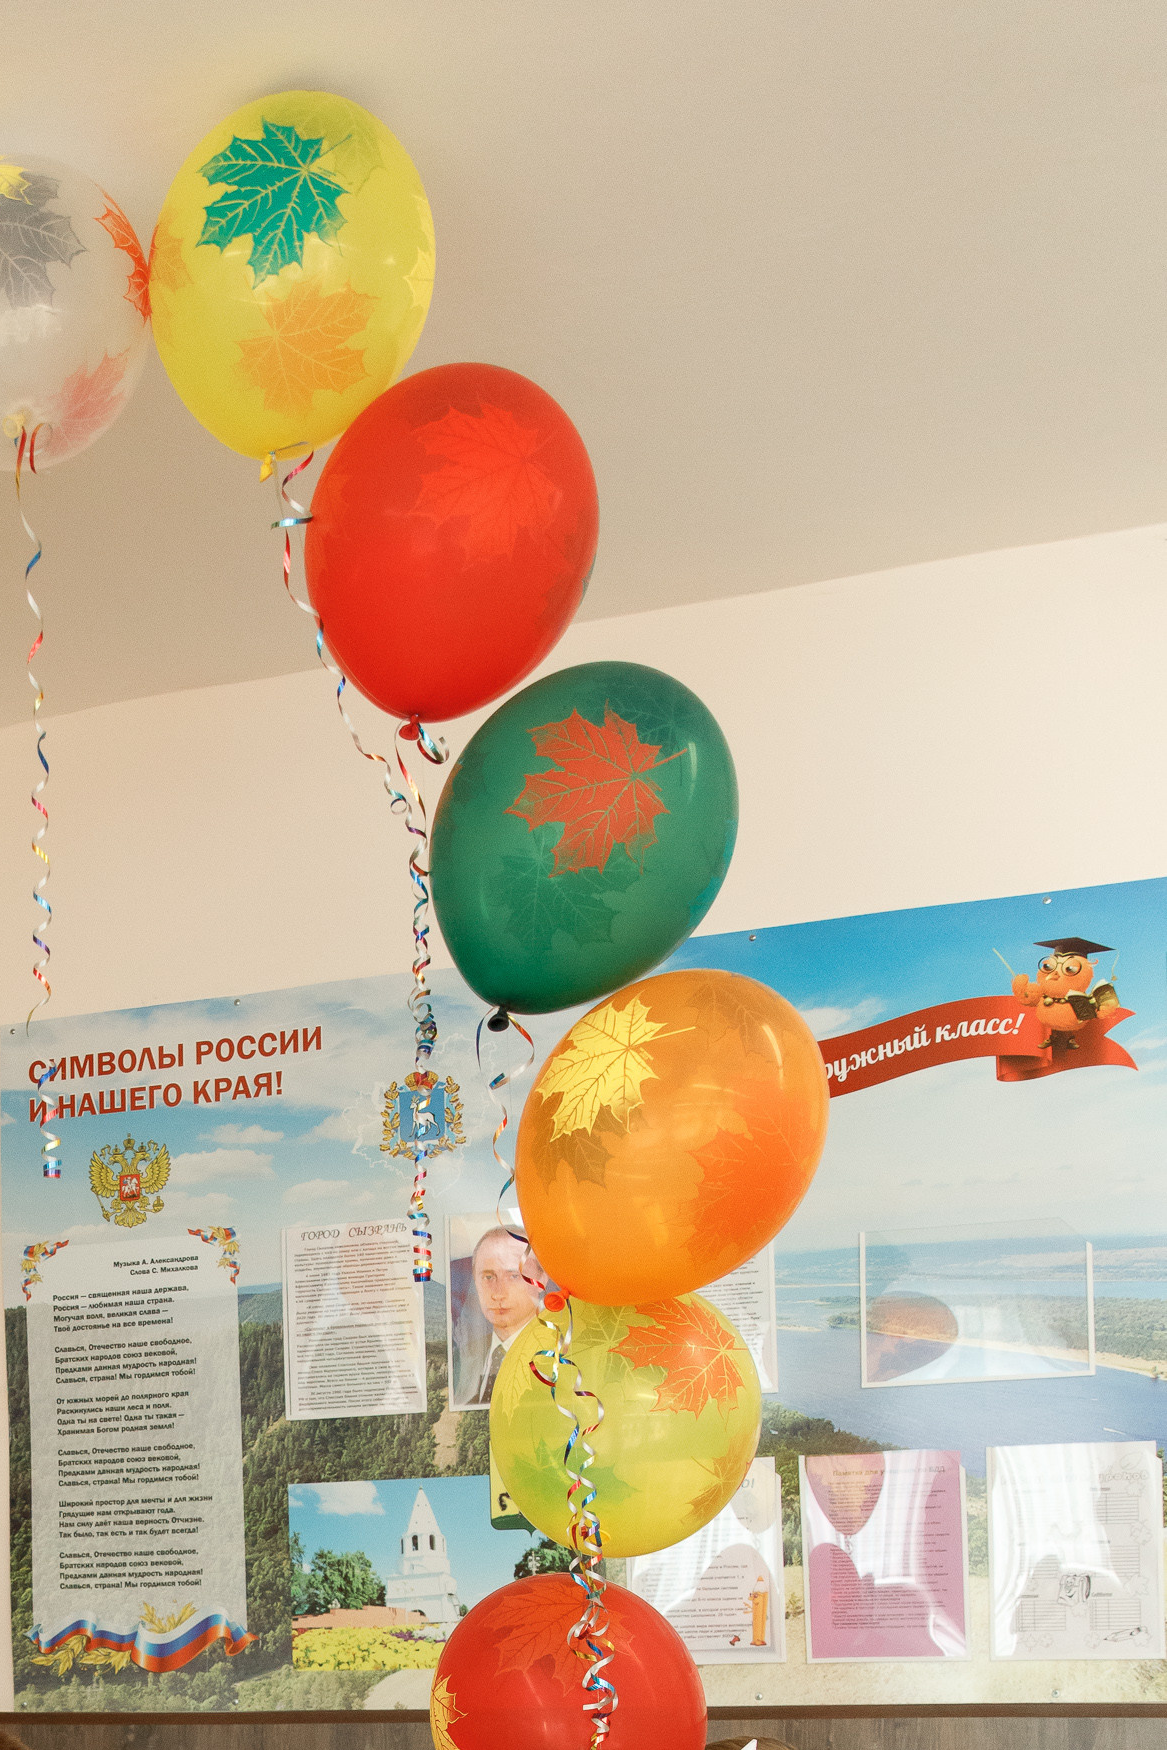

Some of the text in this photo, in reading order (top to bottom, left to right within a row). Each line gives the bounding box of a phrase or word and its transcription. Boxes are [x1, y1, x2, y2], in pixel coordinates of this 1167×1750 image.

[935, 1013, 1026, 1044] класс!
[28, 1026, 322, 1084] СИМВОЛЫ РОССИИ
[29, 1070, 283, 1123] И НАШЕГО КРАЯ!
[300, 1222, 407, 1241] ГОРОД СЫЗРАНЬ
[113, 1261, 140, 1269] Музыка
[150, 1256, 199, 1264] Александрова
[160, 1265, 198, 1273] Михалкова
[88, 1291, 130, 1299] священная
[53, 1315, 84, 1323] Могучая
[72, 1324, 110, 1332] достоянье
[138, 1317, 173, 1327] времена!
[89, 1343, 126, 1351] Отечество
[55, 1356, 88, 1365] Братских
[90, 1354, 121, 1362] народов
[55, 1358, 197, 1375] Предками данная мудрость народная!
[89, 1374, 117, 1382] страна!
[134, 1371, 170, 1380] гордимся
[172, 1368, 196, 1376] тобой!
[95, 1394, 119, 1403] морей
[171, 1391, 189, 1399] края
[99, 1415, 122, 1423] свете!
[150, 1422, 175, 1431] земля!
[58, 1470, 95, 1478] Предками
[162, 1463, 200, 1472] народная!
[93, 1478, 120, 1486] страна!
[59, 1500, 93, 1508] Широкий
[59, 1511, 94, 1519] Грядущие
[149, 1528, 169, 1536] будет
